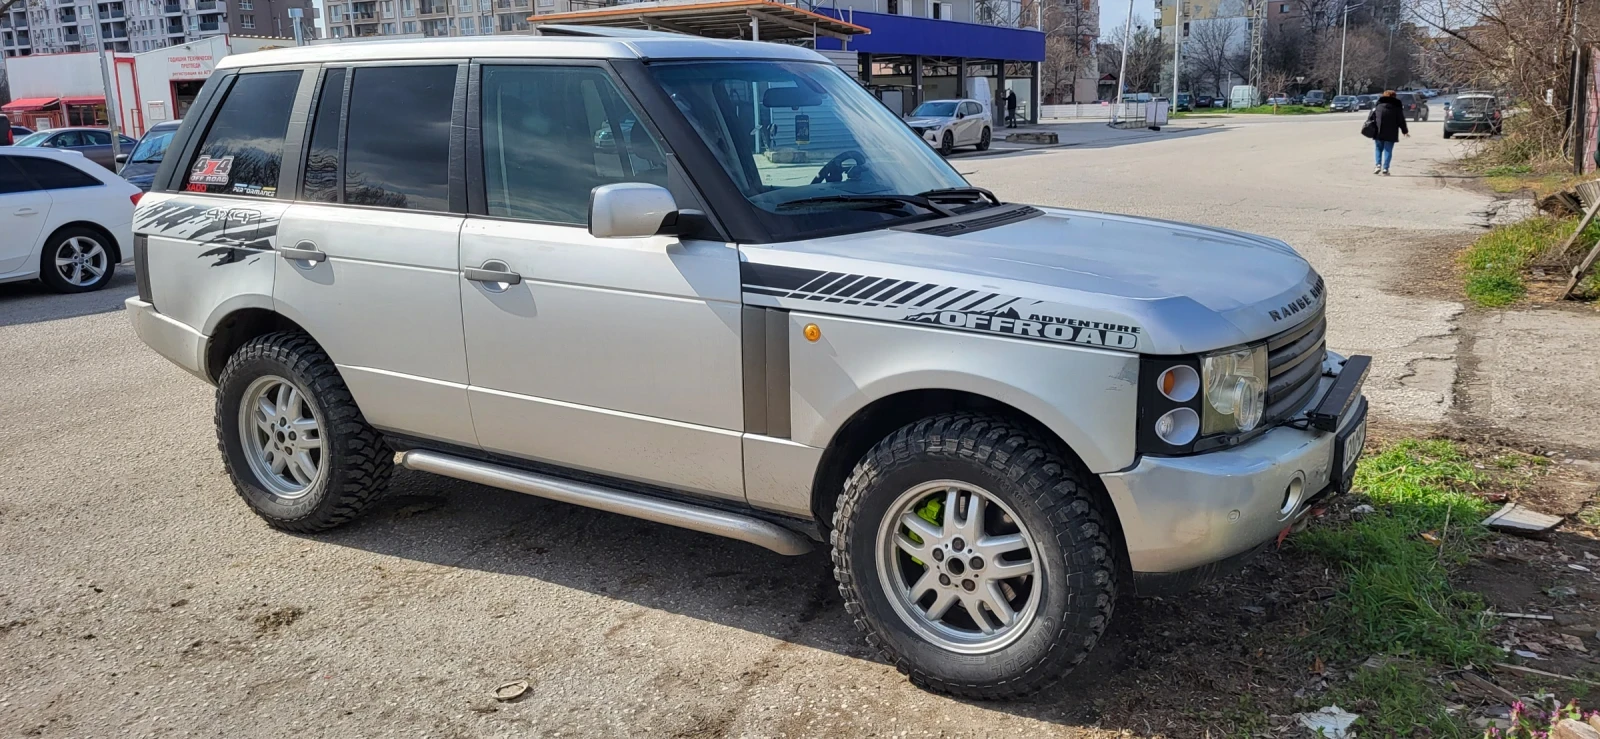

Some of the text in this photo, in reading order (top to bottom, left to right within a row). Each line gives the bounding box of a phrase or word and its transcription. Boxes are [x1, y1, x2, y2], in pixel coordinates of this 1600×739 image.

[1268, 295, 1312, 322] RANGE
[939, 311, 1138, 349] OFFROAD
[1028, 313, 1141, 334] ADVENTURE
